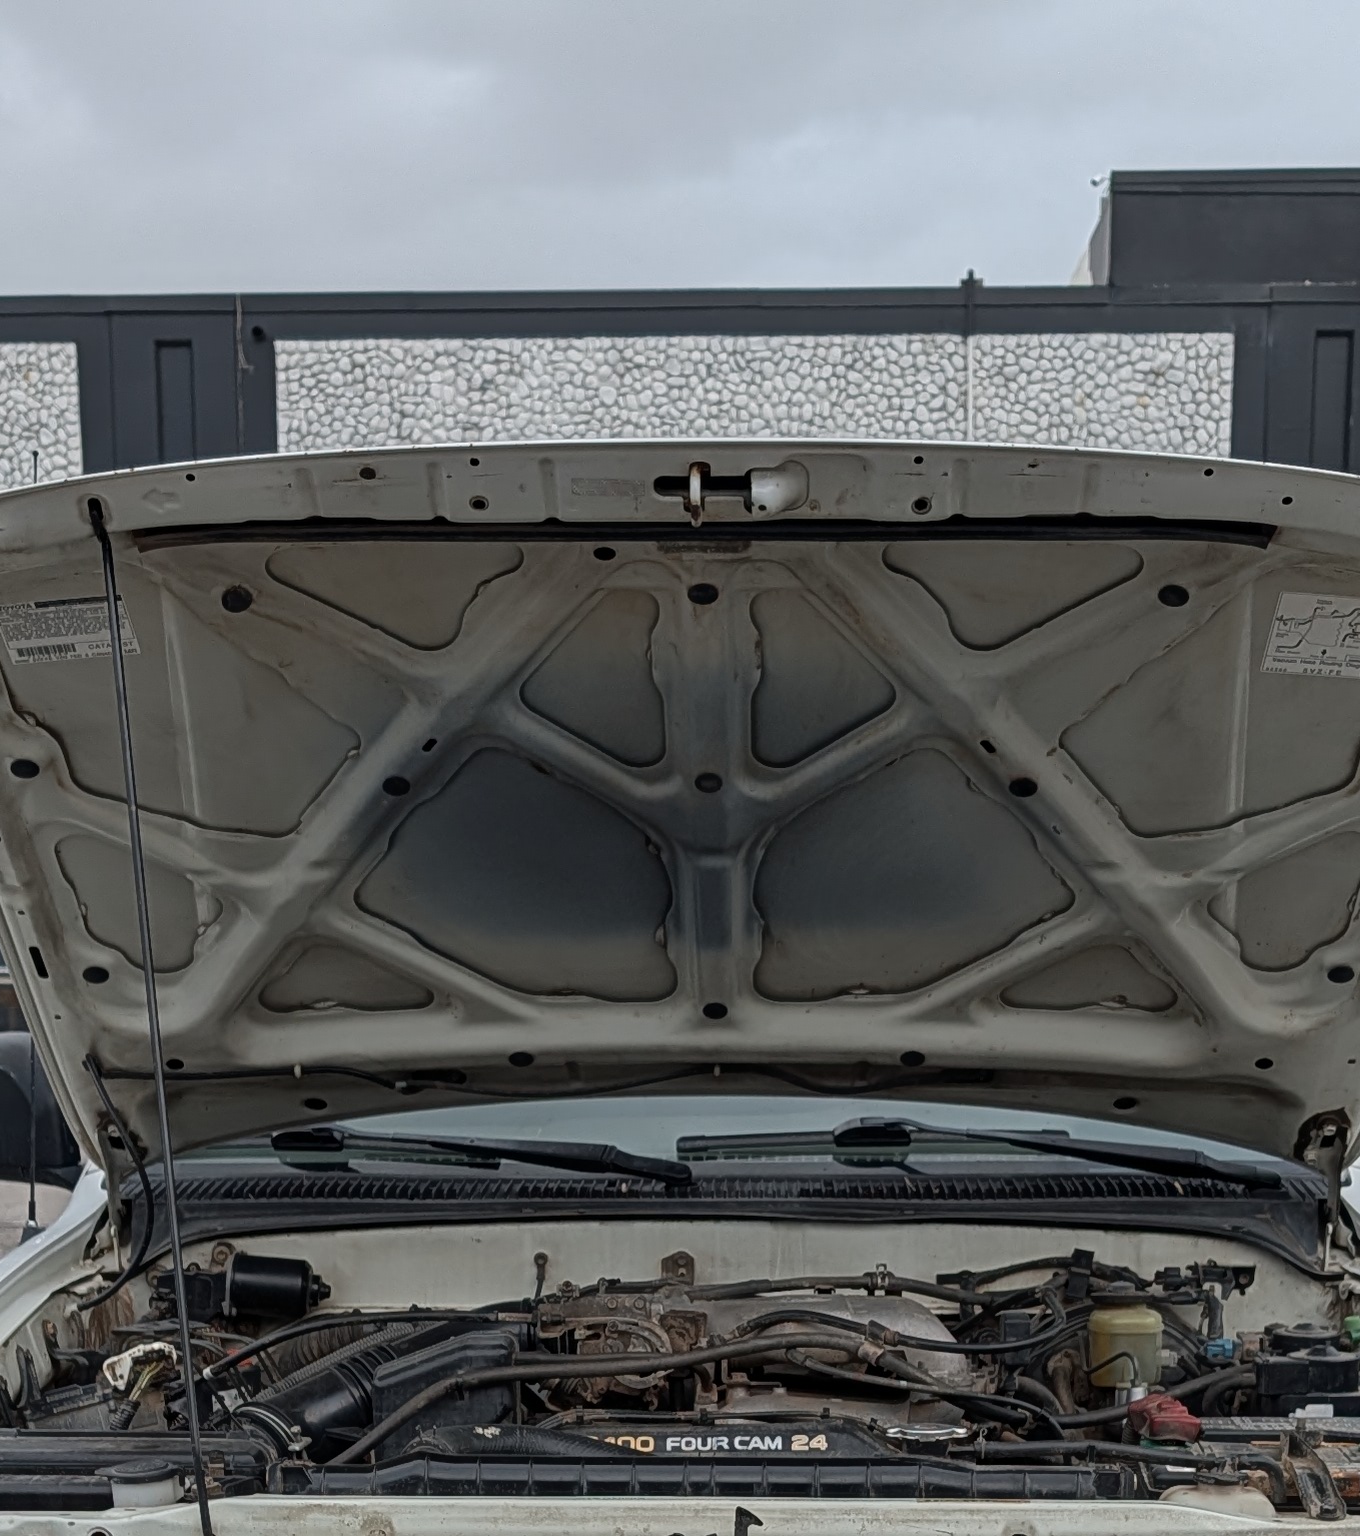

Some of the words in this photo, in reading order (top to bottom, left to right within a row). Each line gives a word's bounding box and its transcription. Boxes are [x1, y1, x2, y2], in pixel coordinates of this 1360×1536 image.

[88, 642, 134, 650] CATAST
[666, 1436, 730, 1452] FOUR
[733, 1436, 782, 1451] CAM
[791, 1434, 828, 1452] 24
